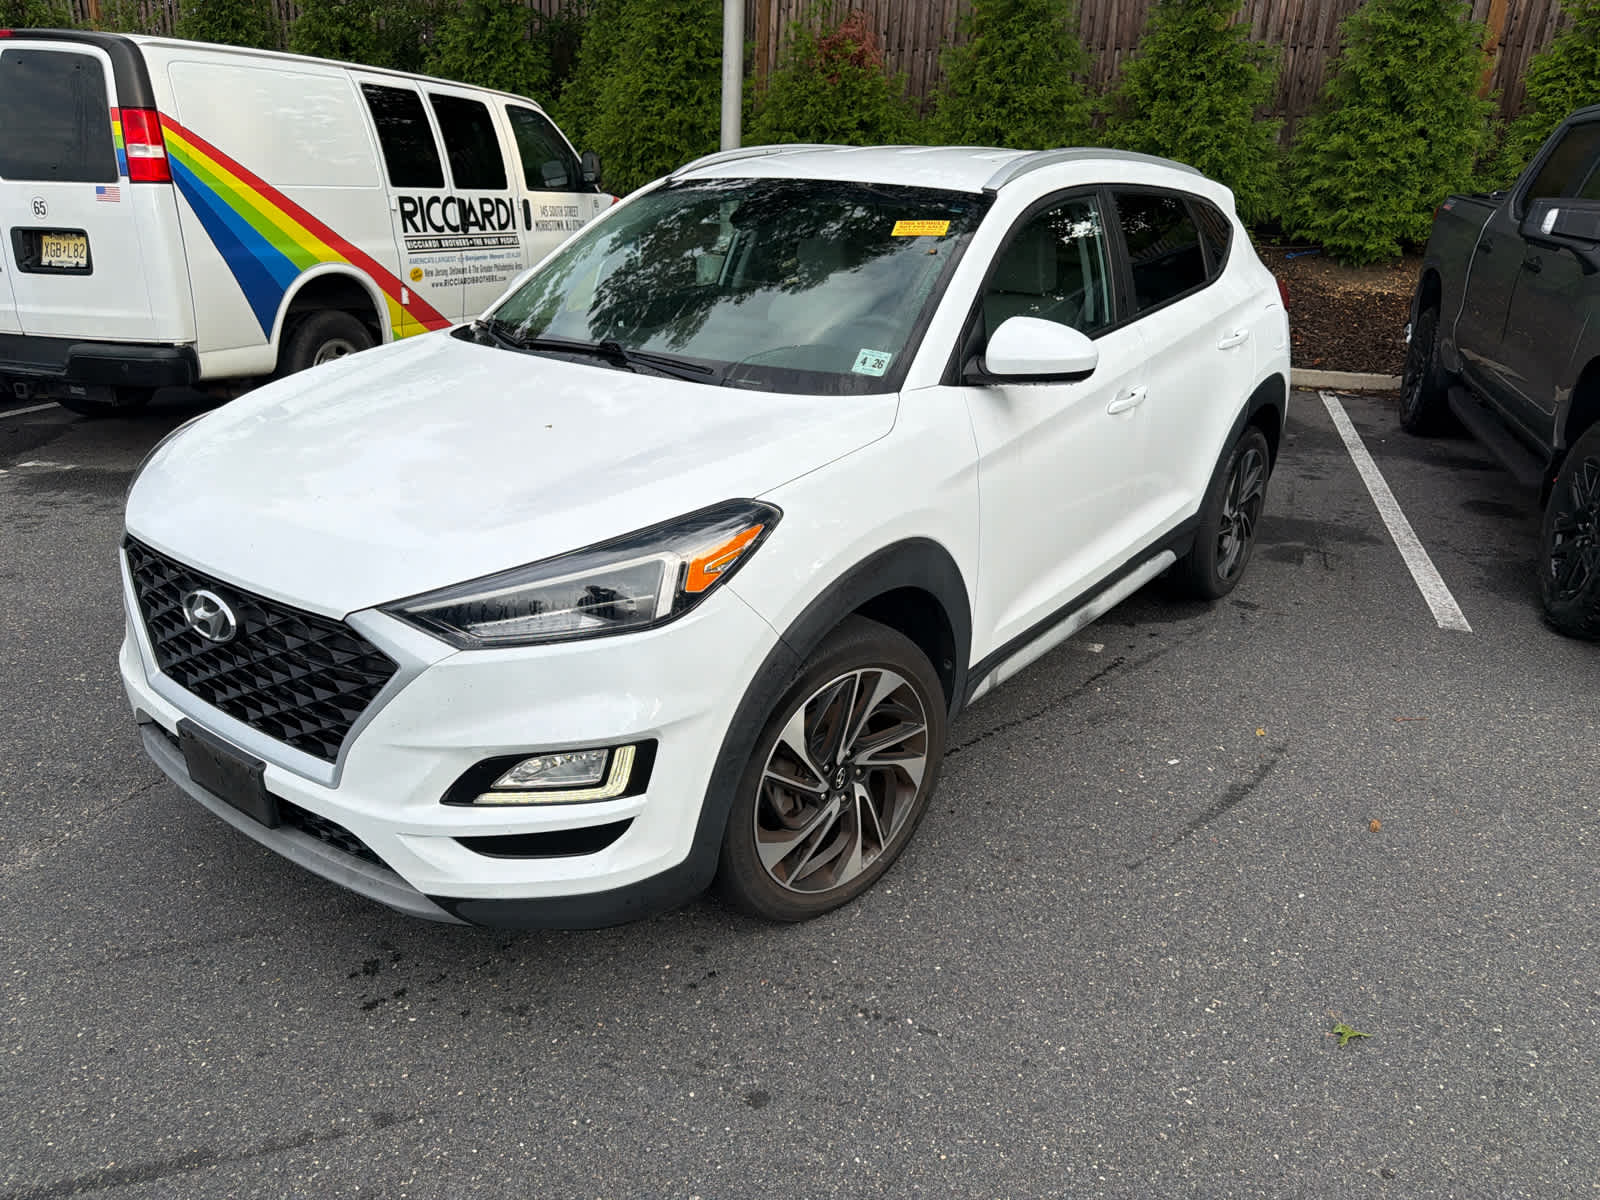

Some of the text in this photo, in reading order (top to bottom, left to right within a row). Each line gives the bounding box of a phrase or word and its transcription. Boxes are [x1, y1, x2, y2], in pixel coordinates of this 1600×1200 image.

[33, 200, 46, 215] 65
[398, 195, 516, 233] RICCIARDI
[564, 205, 578, 217] STREET
[406, 240, 440, 249] RICCIARDI
[441, 238, 470, 248] BROTHERS
[485, 237, 498, 246] PAINT
[500, 236, 519, 245] PEOPLE
[45, 242, 85, 259] XGB L82
[860, 356, 885, 369] 4 26
